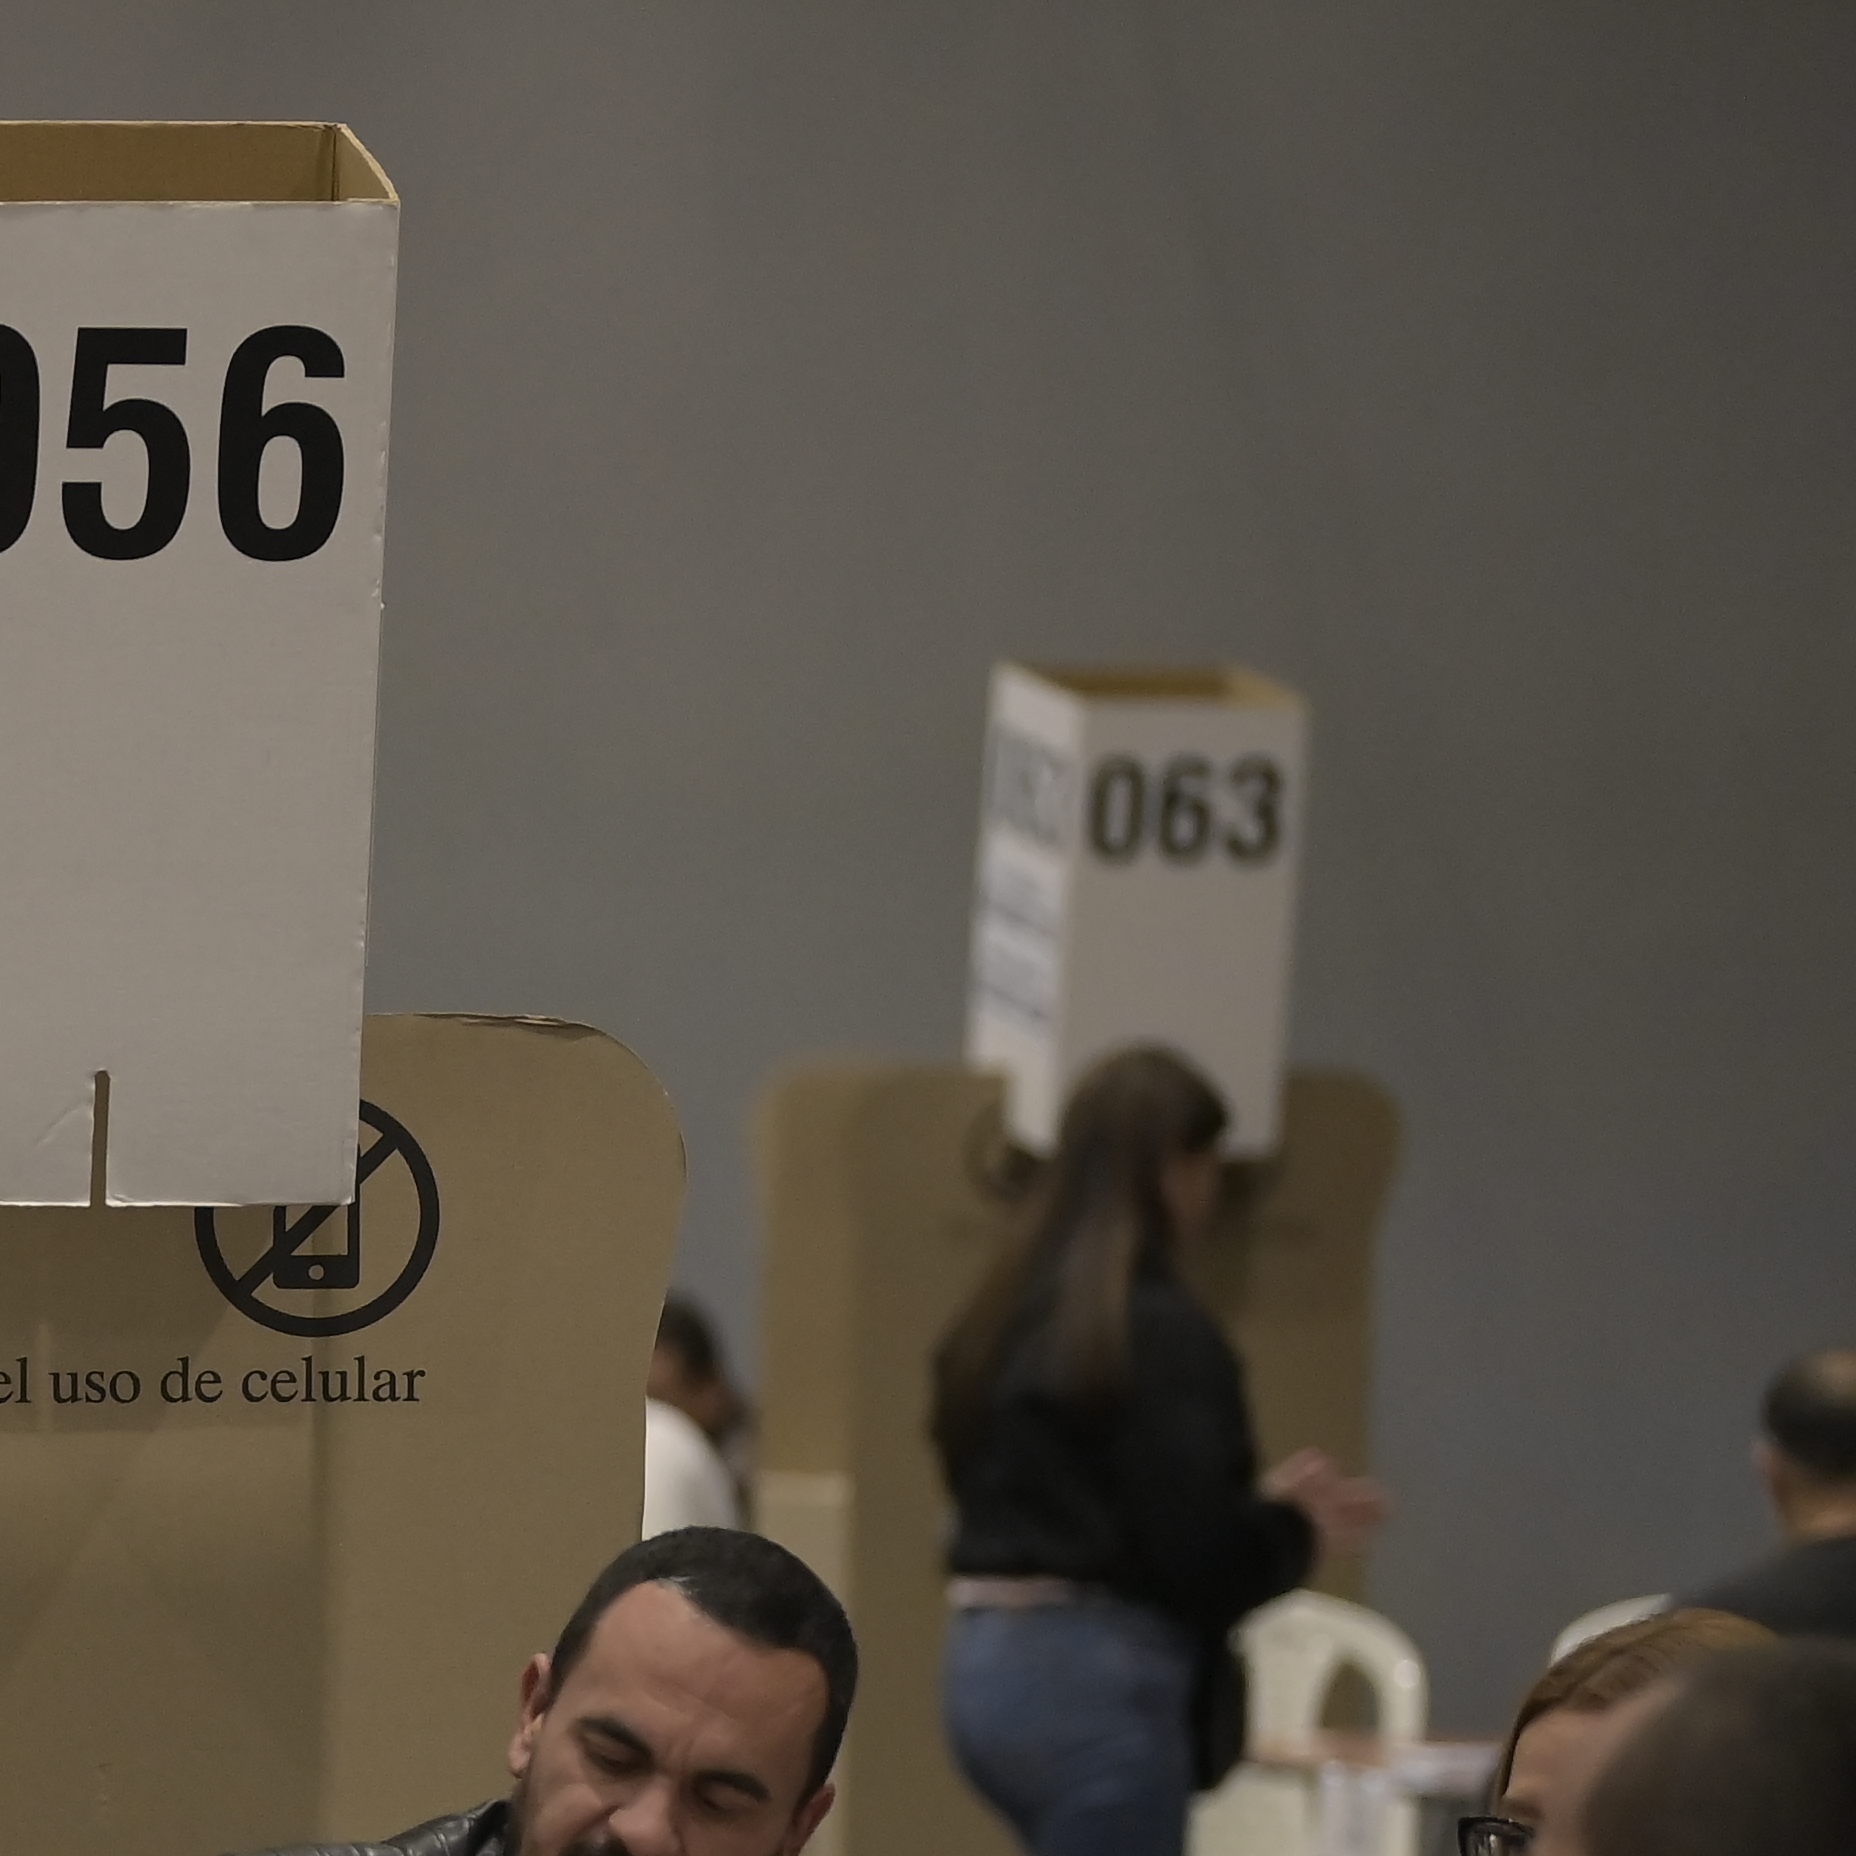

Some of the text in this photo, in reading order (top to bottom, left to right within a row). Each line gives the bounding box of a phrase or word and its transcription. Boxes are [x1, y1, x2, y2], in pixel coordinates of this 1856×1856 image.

[1087, 752, 1288, 866] 063
[50, 1368, 142, 1405] uso
[158, 1356, 223, 1404] de
[238, 1356, 426, 1404] celular
